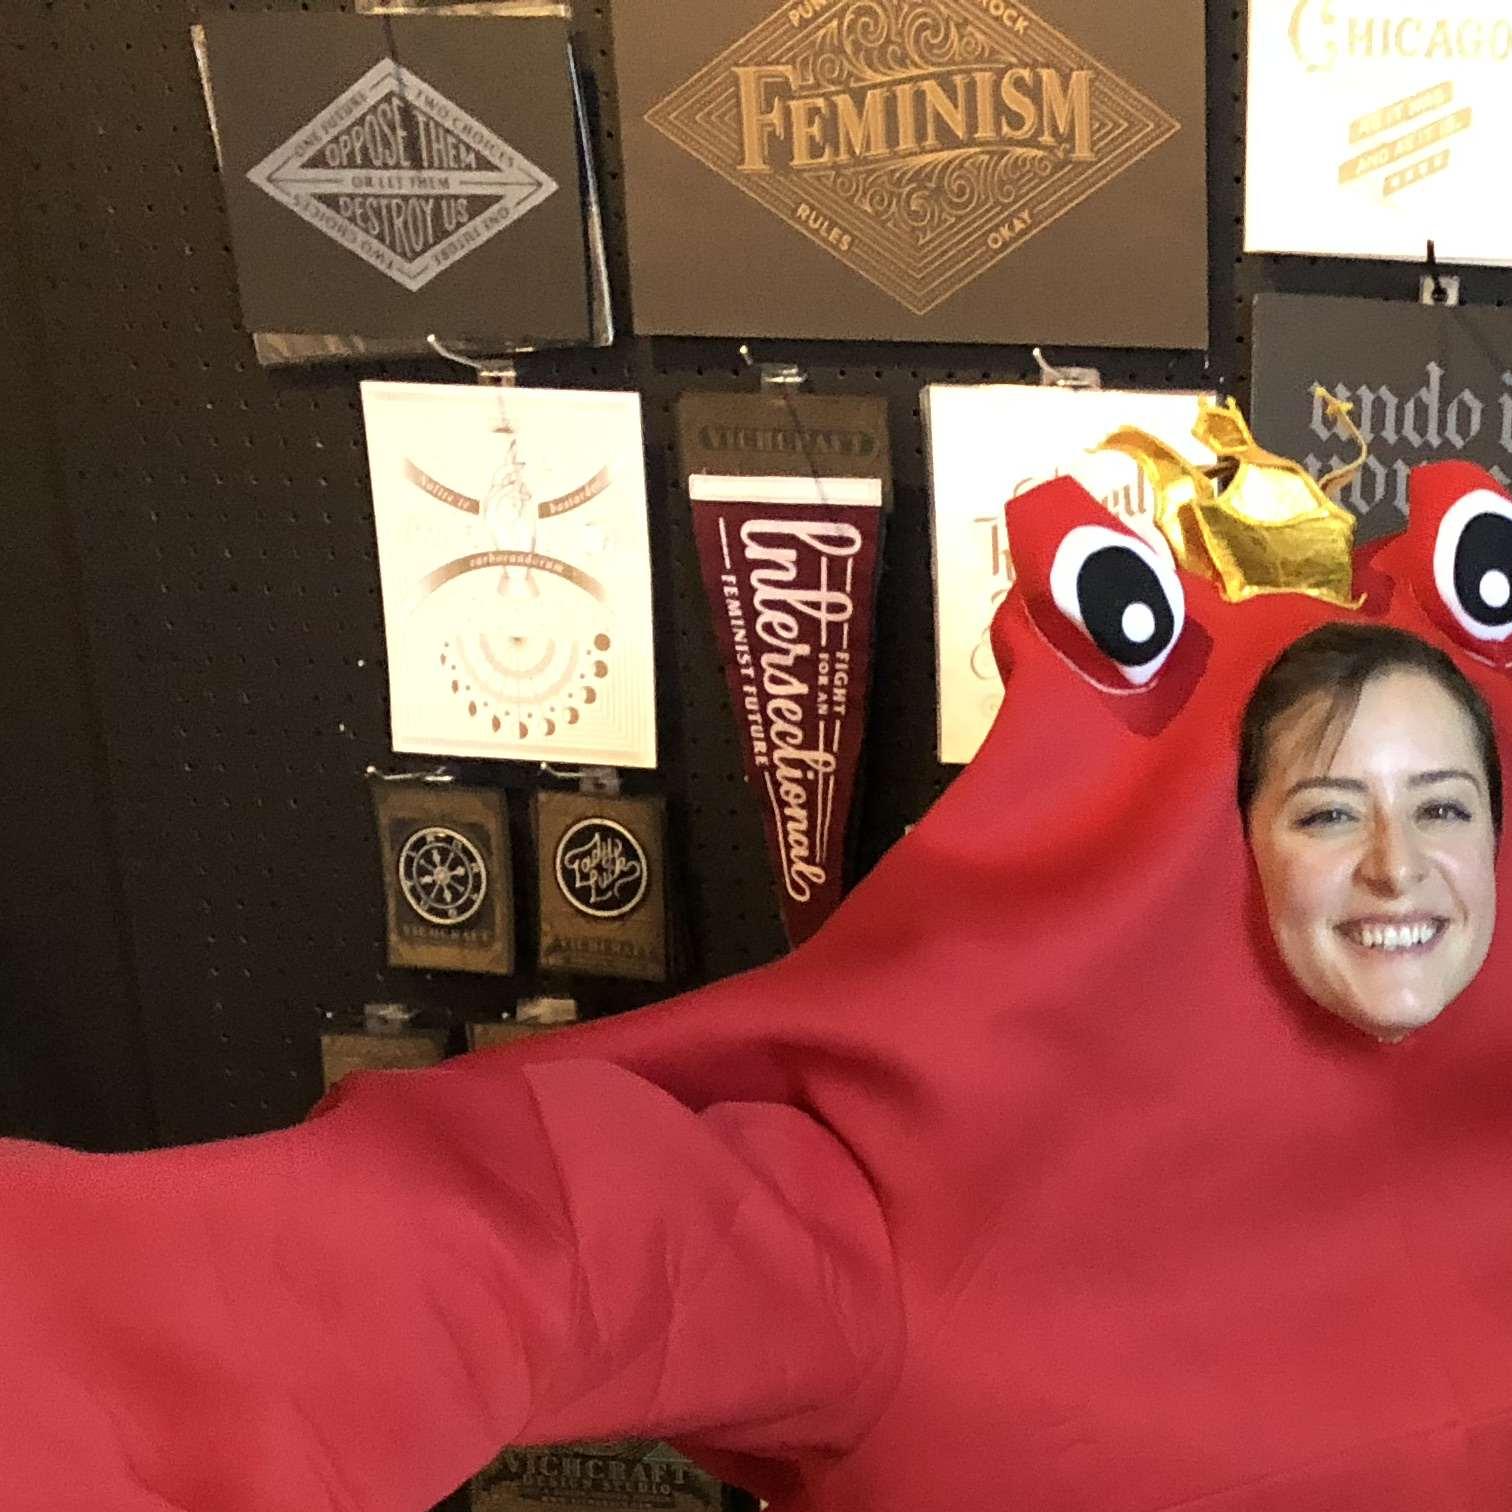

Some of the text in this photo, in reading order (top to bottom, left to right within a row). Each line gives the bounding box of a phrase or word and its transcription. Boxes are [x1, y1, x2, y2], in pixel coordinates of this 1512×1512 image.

[982, 0, 1029, 35] OCK
[325, 96, 476, 169] OPPOSE THEM
[731, 64, 1097, 172] FEMINISM
[339, 197, 469, 258] DESTROY US
[795, 204, 853, 253] RULES
[986, 210, 1034, 250] OKAY
[1309, 361, 1484, 449] undo
[722, 574, 769, 766] FEMINIST FUTURE
[817, 652, 829, 715] FOR AN
[834, 651, 850, 716] FIGHT
[741, 518, 863, 902] Intersectional
